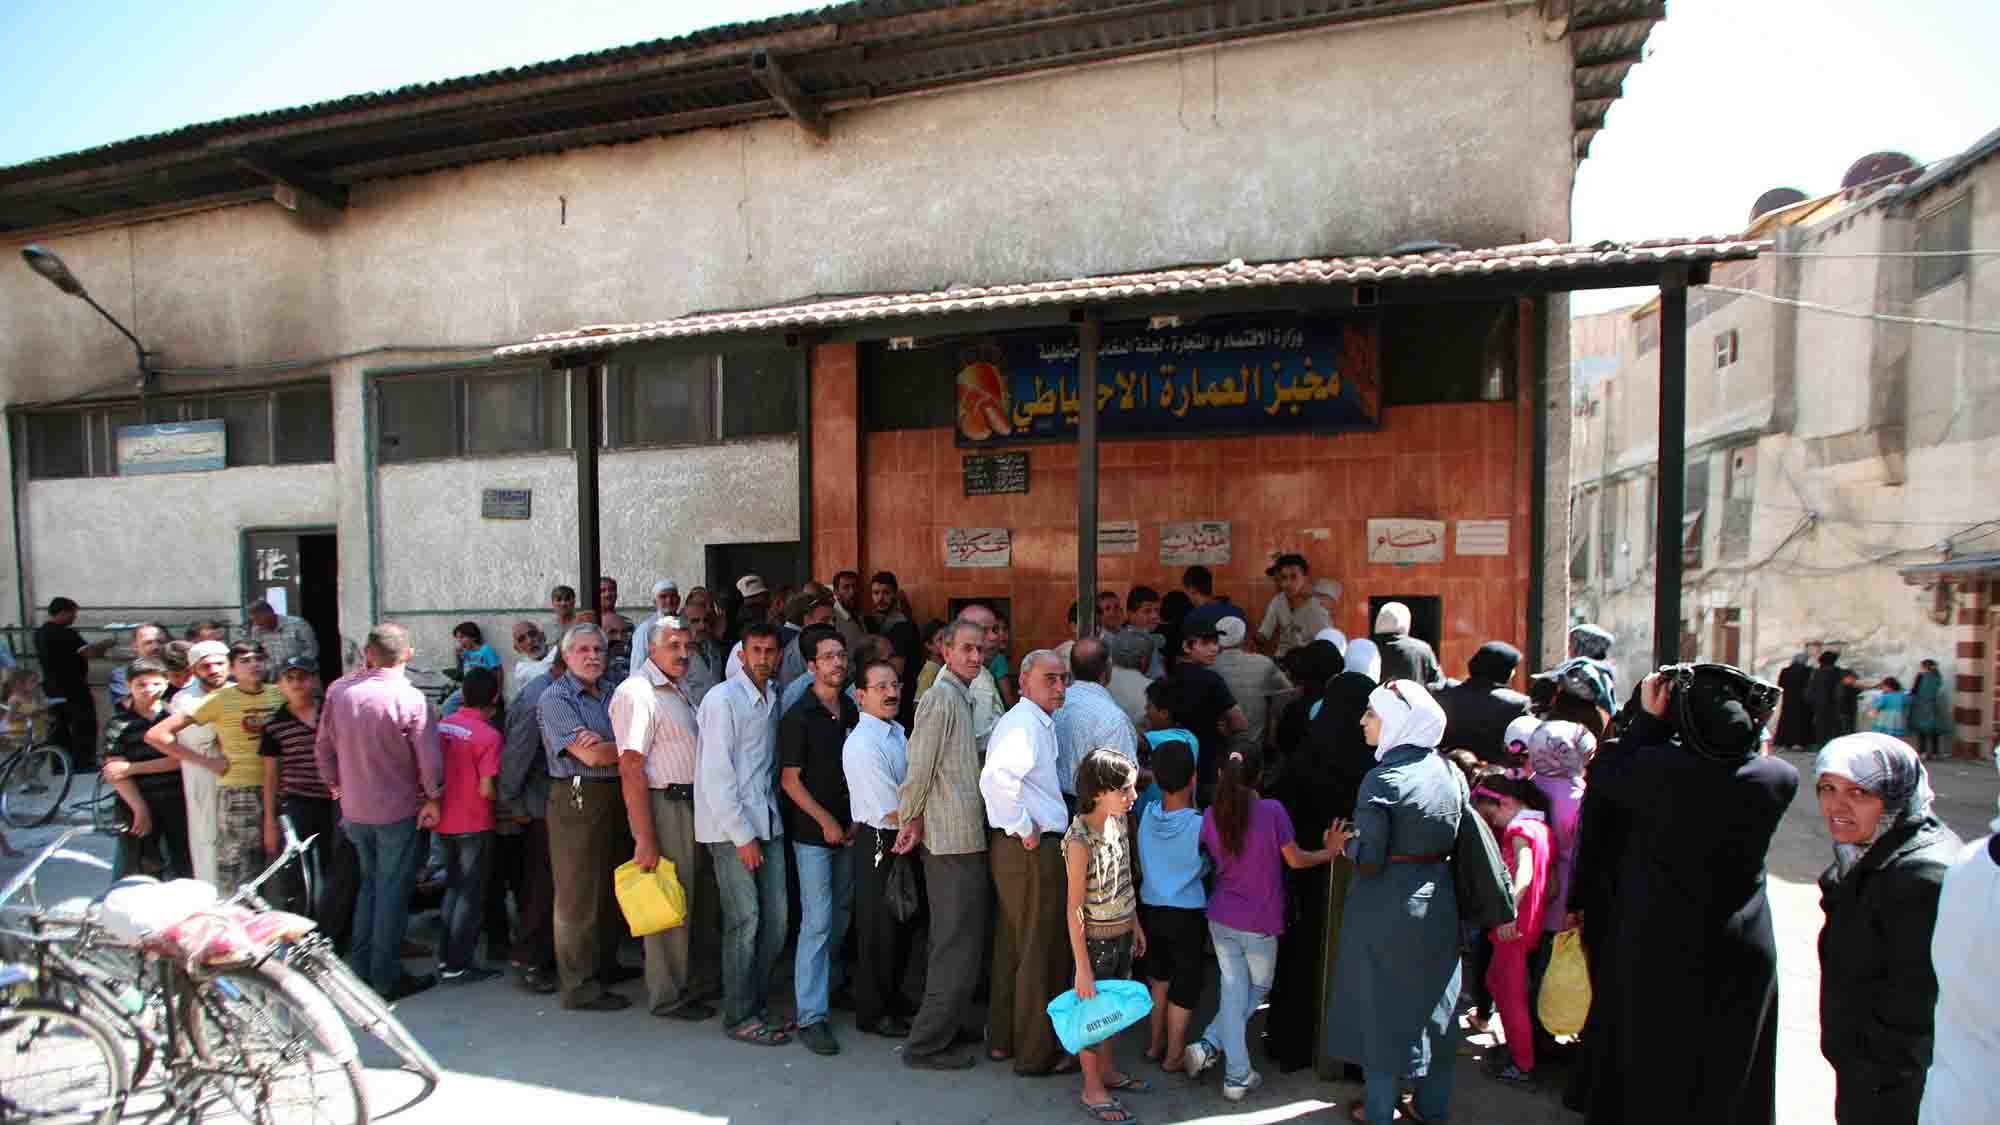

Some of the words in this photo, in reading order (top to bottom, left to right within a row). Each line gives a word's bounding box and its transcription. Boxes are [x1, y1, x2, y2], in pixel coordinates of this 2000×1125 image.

[1013, 369, 1147, 433] الاحياطي
[1159, 362, 1260, 418] العمارة
[1264, 357, 1341, 416] مخبز
